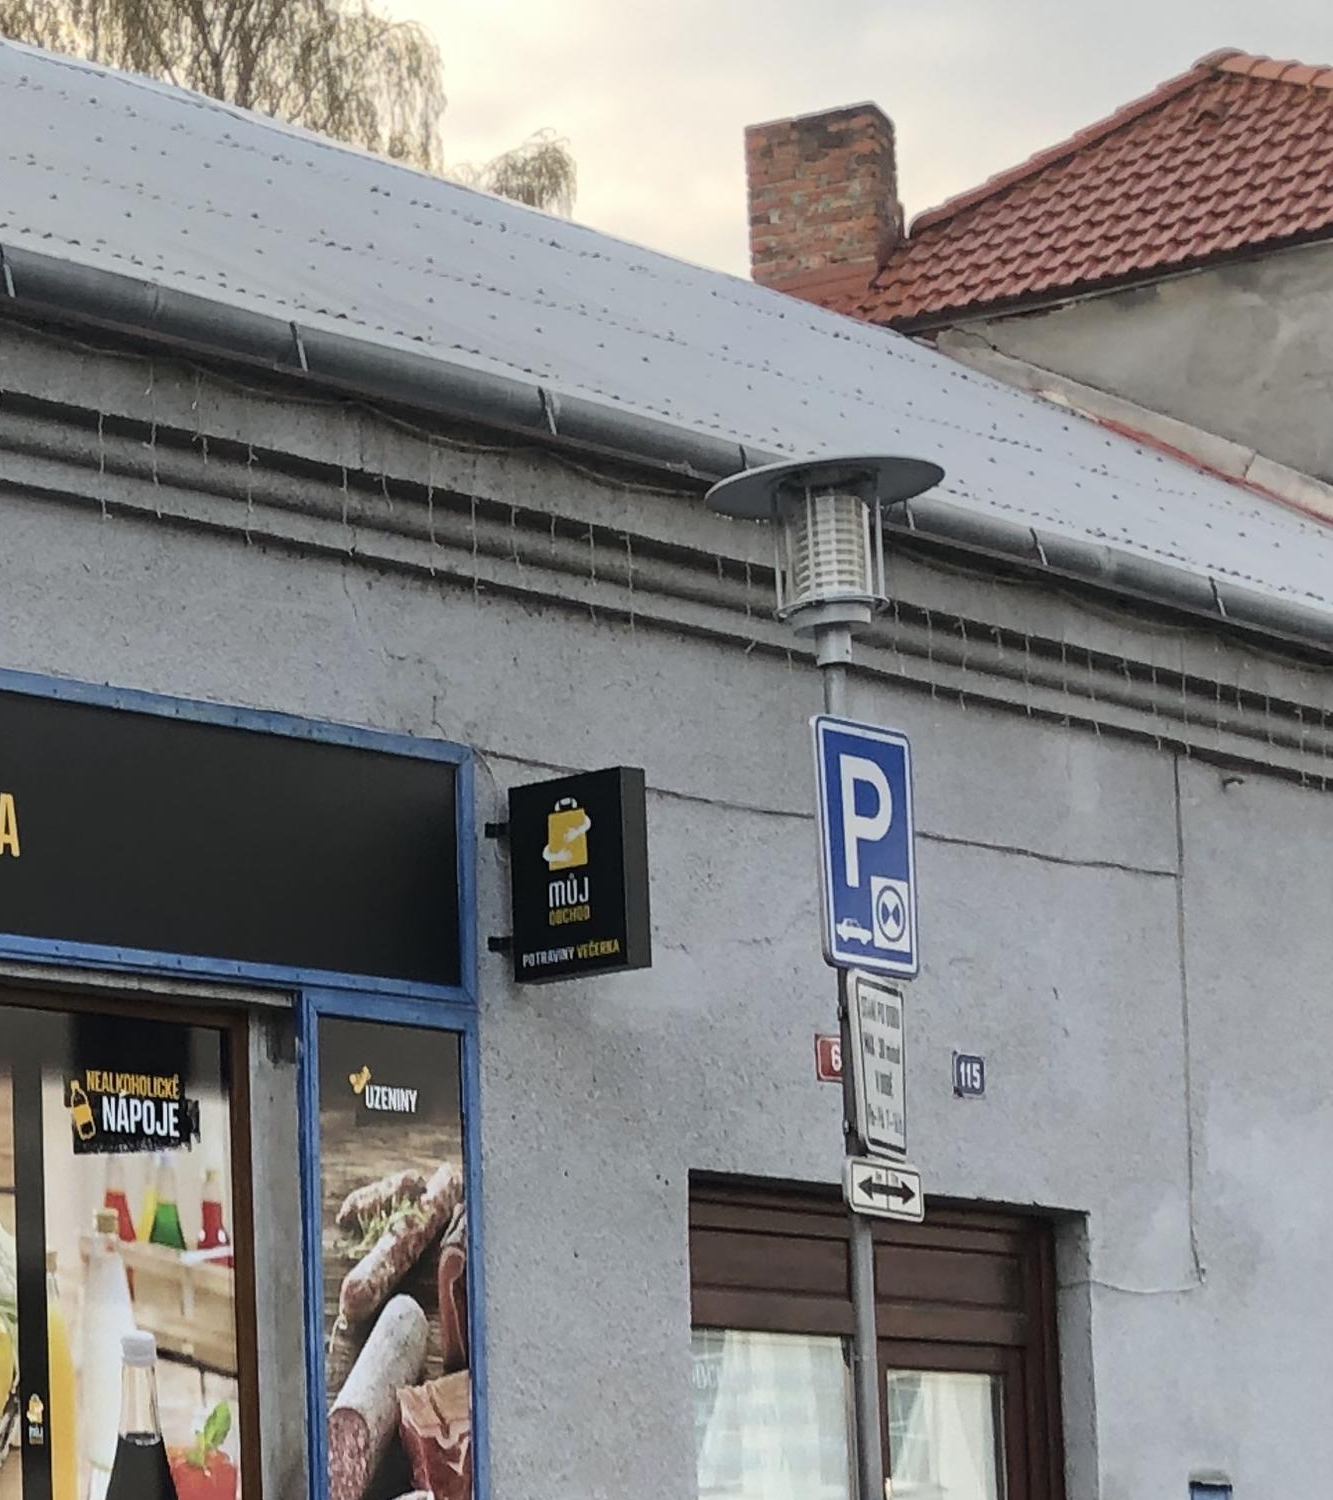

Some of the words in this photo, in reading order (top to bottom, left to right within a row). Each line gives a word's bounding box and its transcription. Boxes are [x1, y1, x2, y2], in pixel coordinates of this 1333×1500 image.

[839, 754, 893, 888] P
[548, 872, 590, 908] MŮJ
[522, 946, 575, 968] POTRAVINY
[576, 938, 621, 959] VEČERKA
[85, 1068, 180, 1101] NEALKOHOLICKÉ
[959, 1060, 981, 1090] 115
[101, 1088, 180, 1138] NÁPOJE
[364, 1083, 418, 1114] UZENINY
